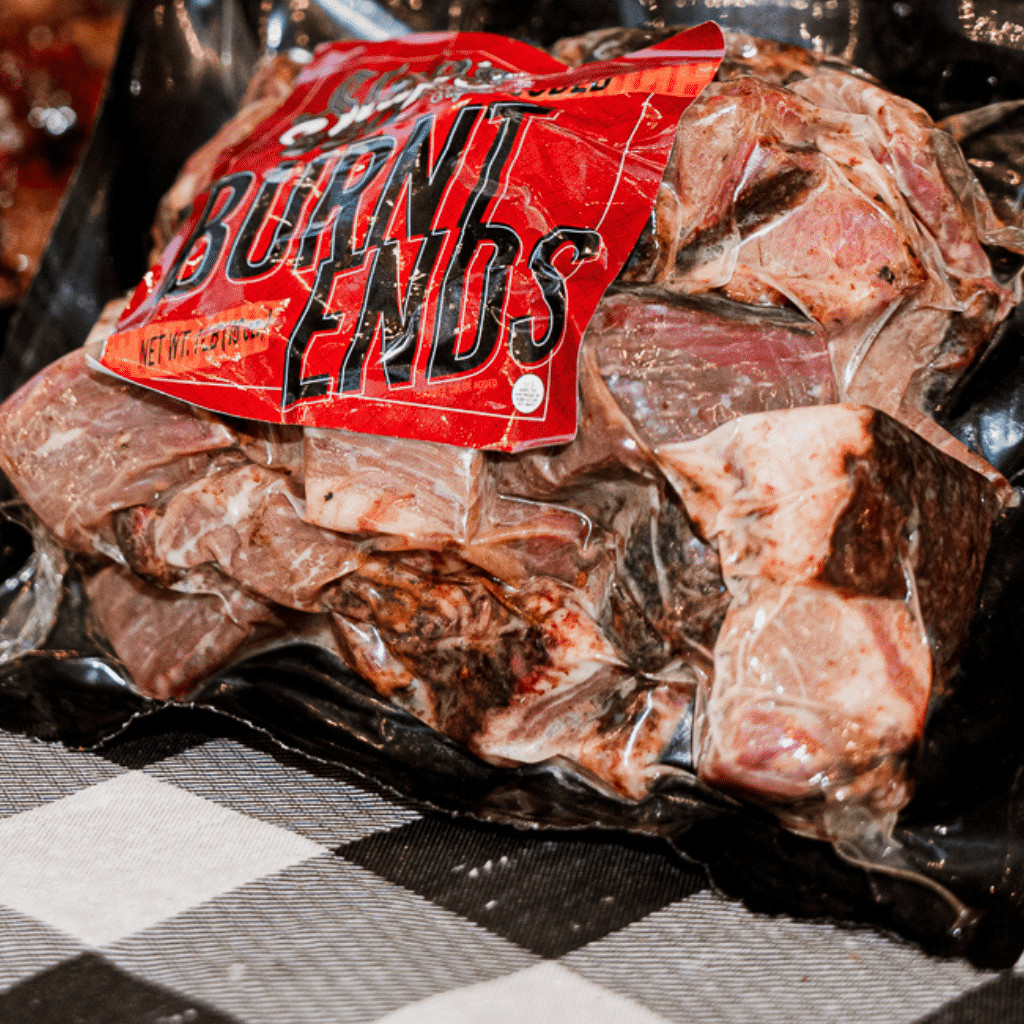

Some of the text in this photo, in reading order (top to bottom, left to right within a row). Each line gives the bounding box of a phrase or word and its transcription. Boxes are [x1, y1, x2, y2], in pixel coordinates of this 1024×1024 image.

[159, 101, 564, 302] BURNT
[140, 333, 166, 367] NET
[167, 330, 192, 361] WT.
[281, 225, 603, 412] ENDS
